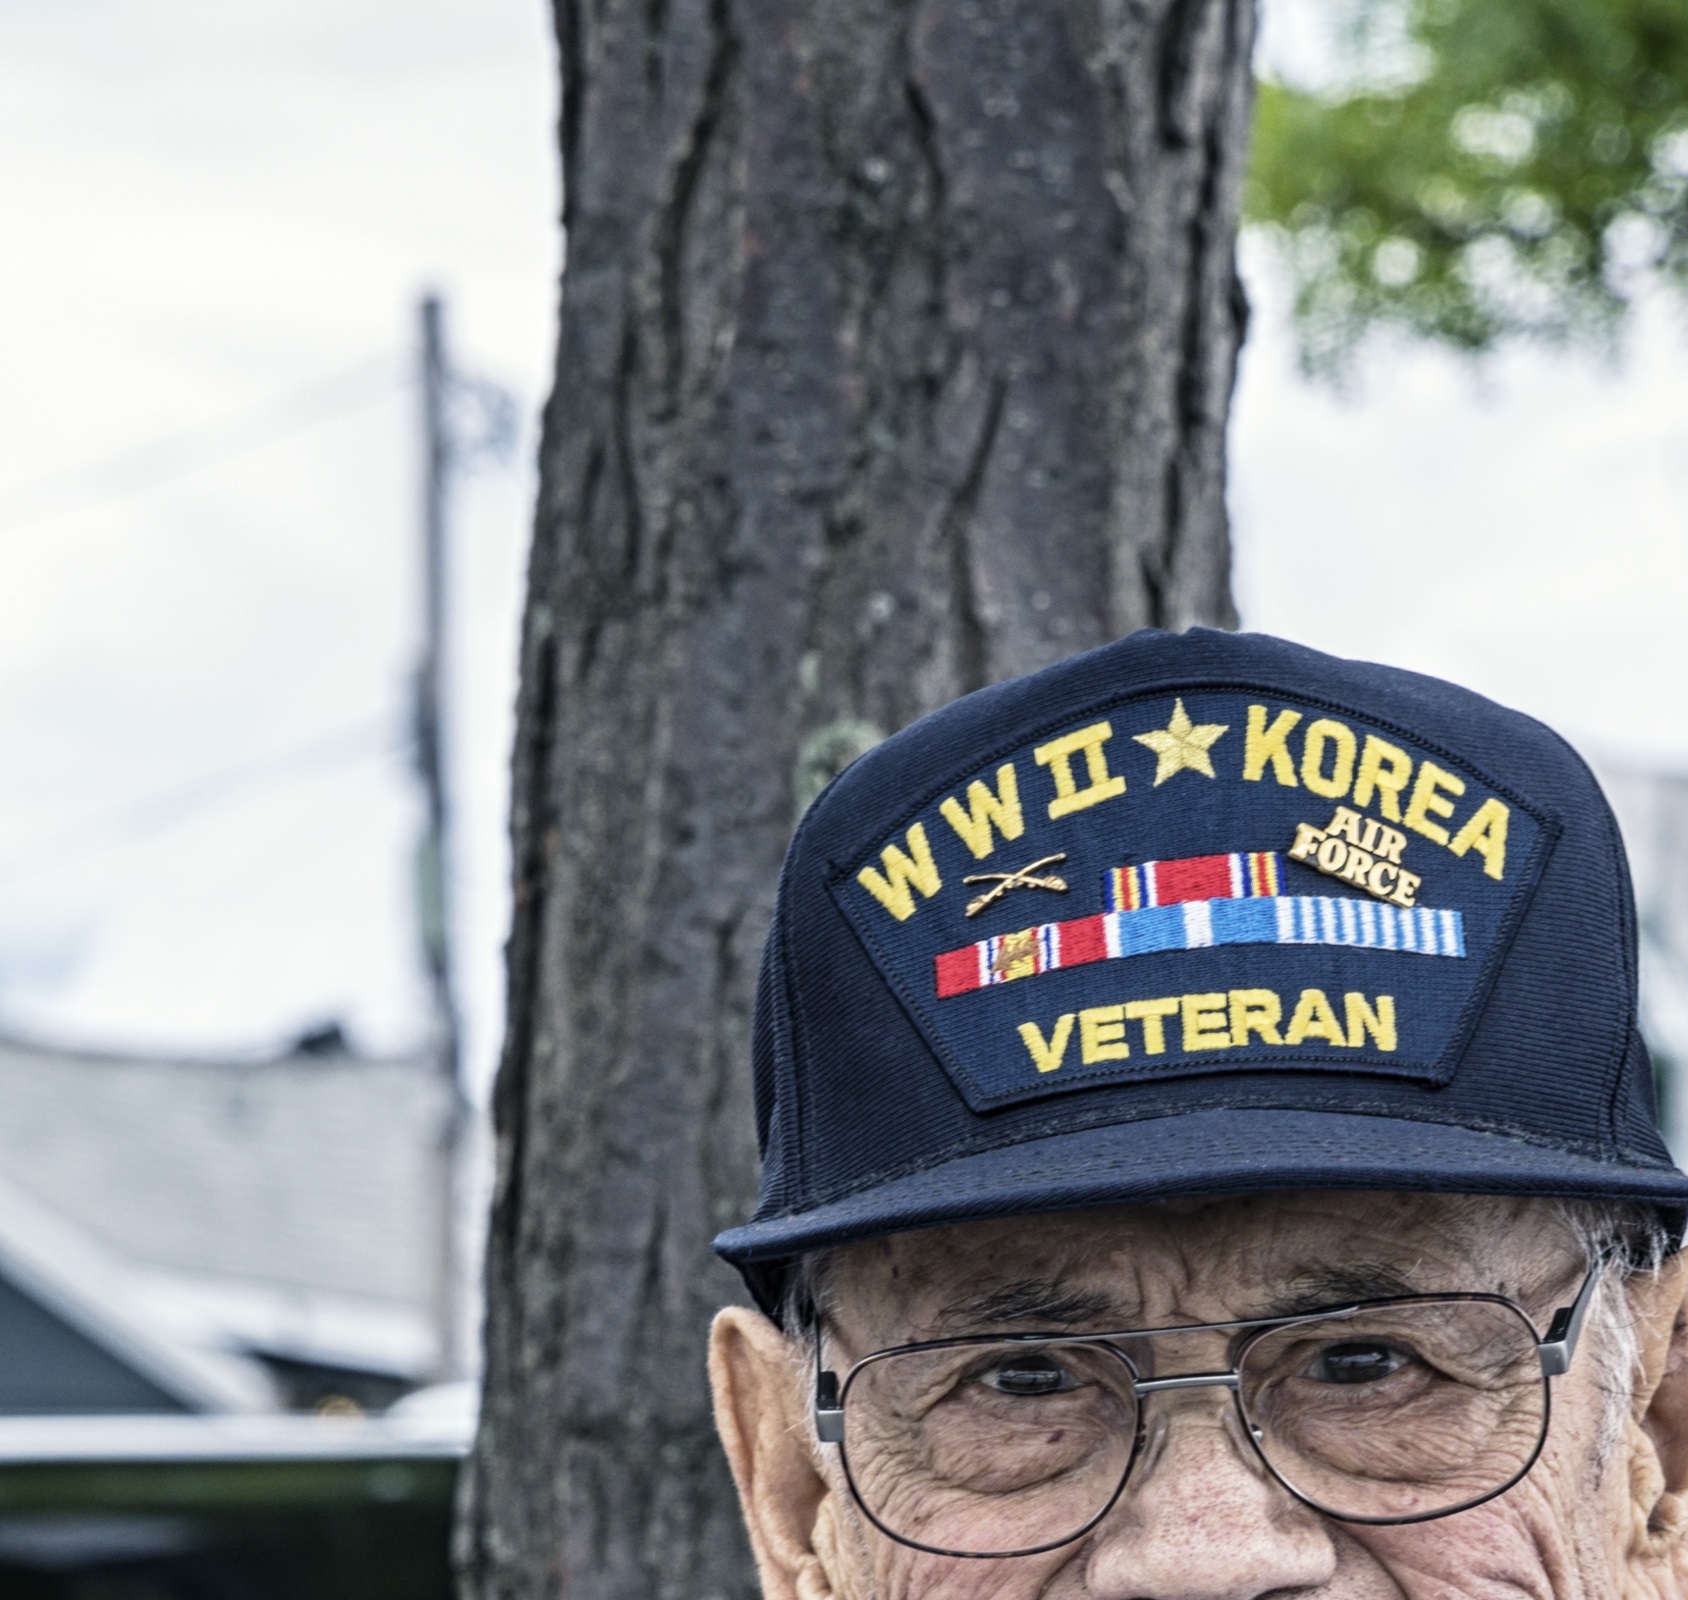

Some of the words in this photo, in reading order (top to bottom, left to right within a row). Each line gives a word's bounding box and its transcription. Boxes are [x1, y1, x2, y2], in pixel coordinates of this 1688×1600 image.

[1242, 704, 1511, 882] KOREA
[1324, 805, 1408, 865] AIR
[1288, 822, 1422, 909] FORCE
[1017, 987, 1396, 1073] VETERAN
